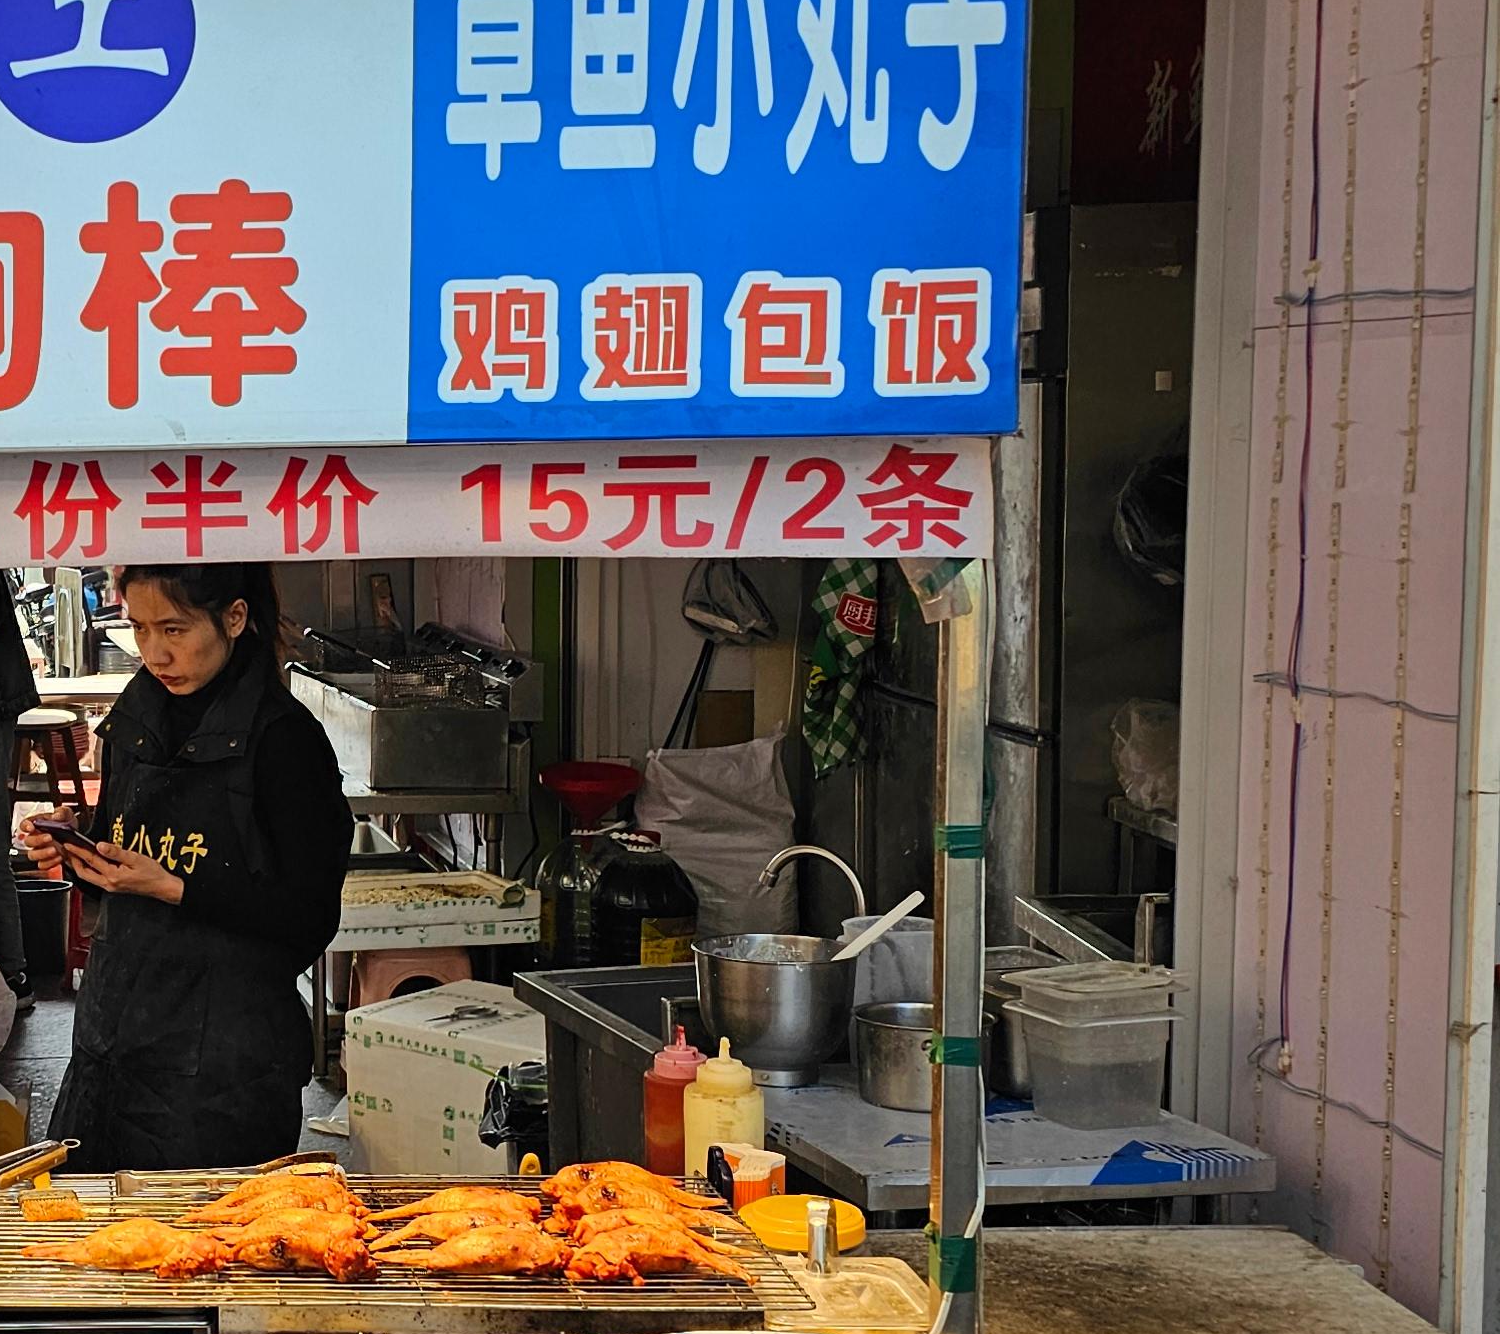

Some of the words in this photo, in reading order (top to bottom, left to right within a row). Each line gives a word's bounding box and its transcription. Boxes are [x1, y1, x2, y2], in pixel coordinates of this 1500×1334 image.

[444, 273, 986, 397] 鸡翅包饭
[460, 444, 975, 552] 15元/2条
